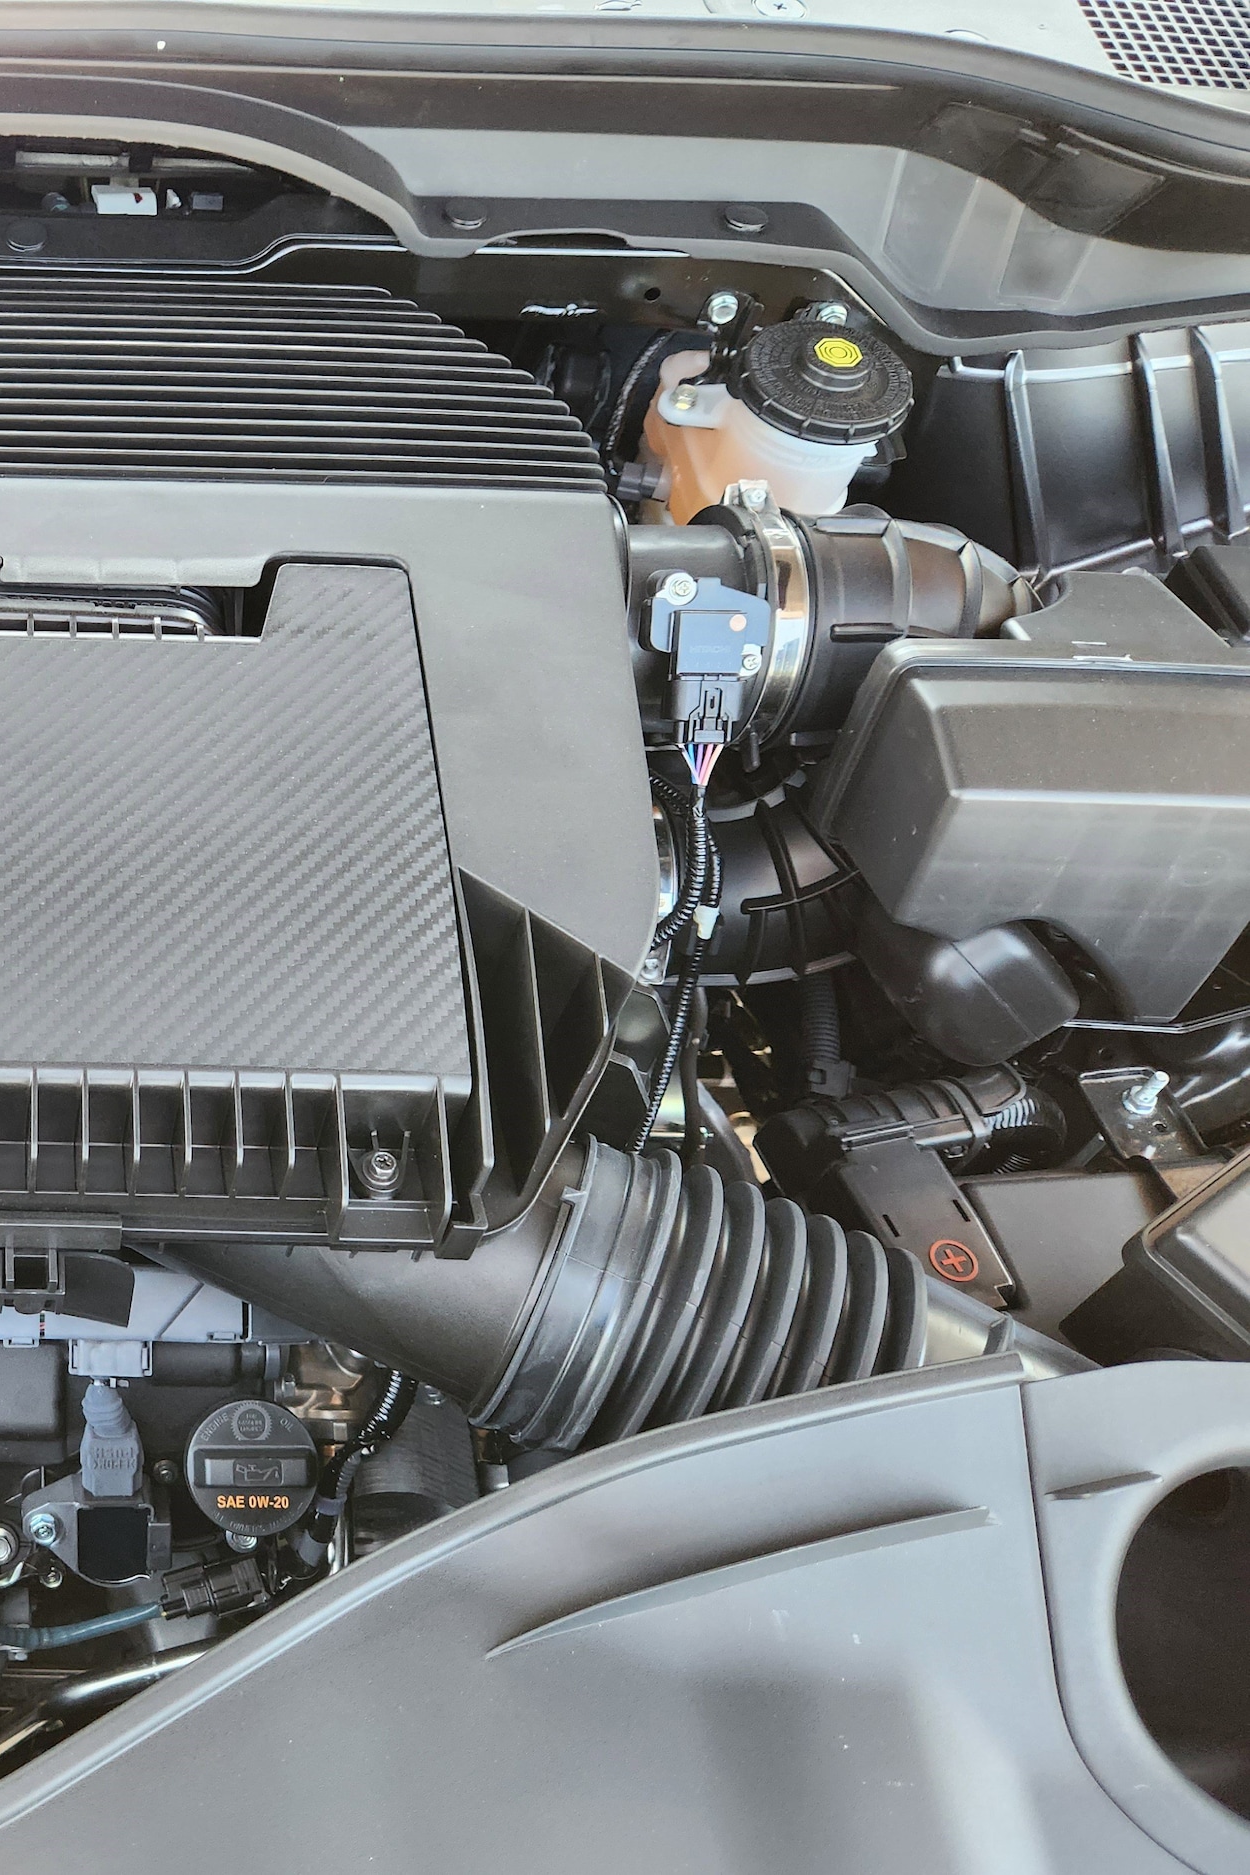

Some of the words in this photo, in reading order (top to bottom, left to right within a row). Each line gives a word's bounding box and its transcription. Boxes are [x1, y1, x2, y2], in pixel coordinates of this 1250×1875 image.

[201, 1412, 229, 1441] ENGINE
[280, 1418, 294, 1432] OIL
[217, 1495, 245, 1509] SAE
[248, 1495, 289, 1509] 0W-20
